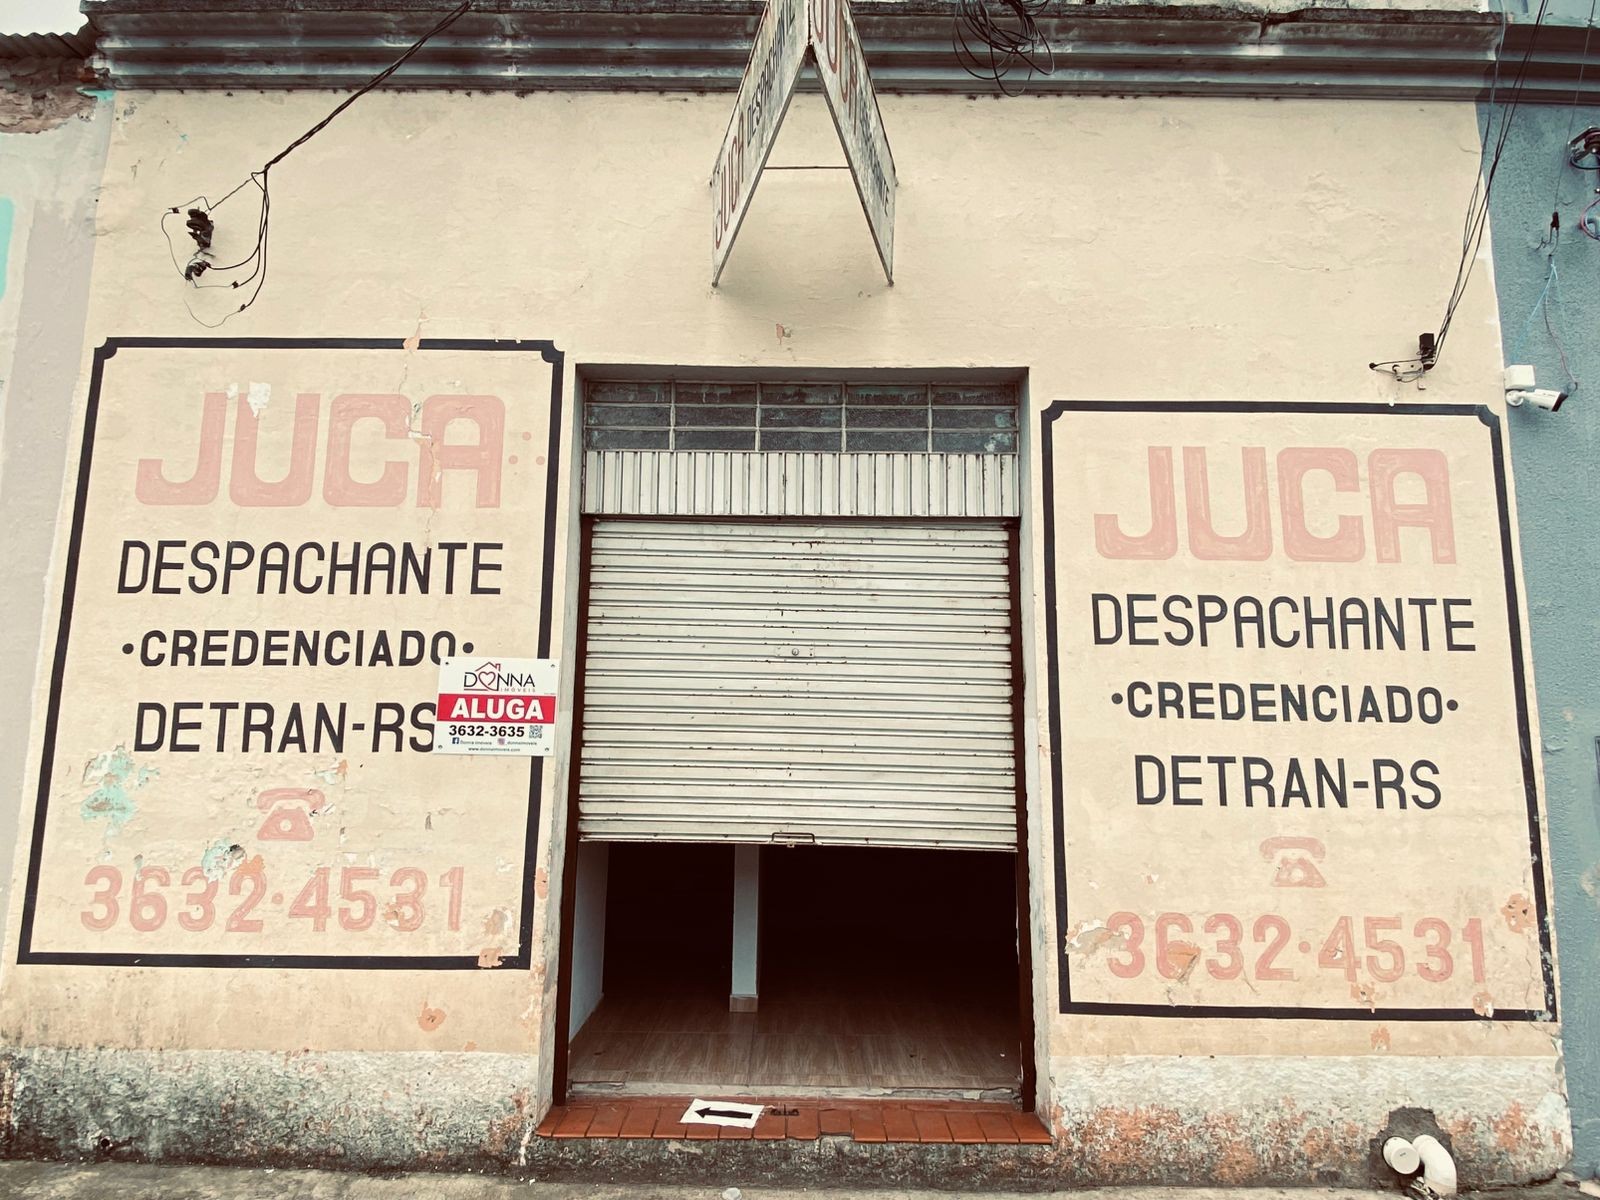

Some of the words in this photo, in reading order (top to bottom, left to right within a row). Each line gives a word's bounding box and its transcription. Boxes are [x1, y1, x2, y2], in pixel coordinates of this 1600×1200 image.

[715, 112, 745, 250] JUCA
[135, 392, 506, 508] JUCA
[1094, 445, 1457, 564] JUCA
[117, 540, 503, 596] DESPACHANTE
[1092, 593, 1476, 652] DESPACHANTE
[134, 702, 438, 752] DETRAN-RS
[448, 724, 525, 737] 3632-3635
[450, 697, 544, 720] ALUGA
[1134, 755, 1442, 809] DETRAN-RS
